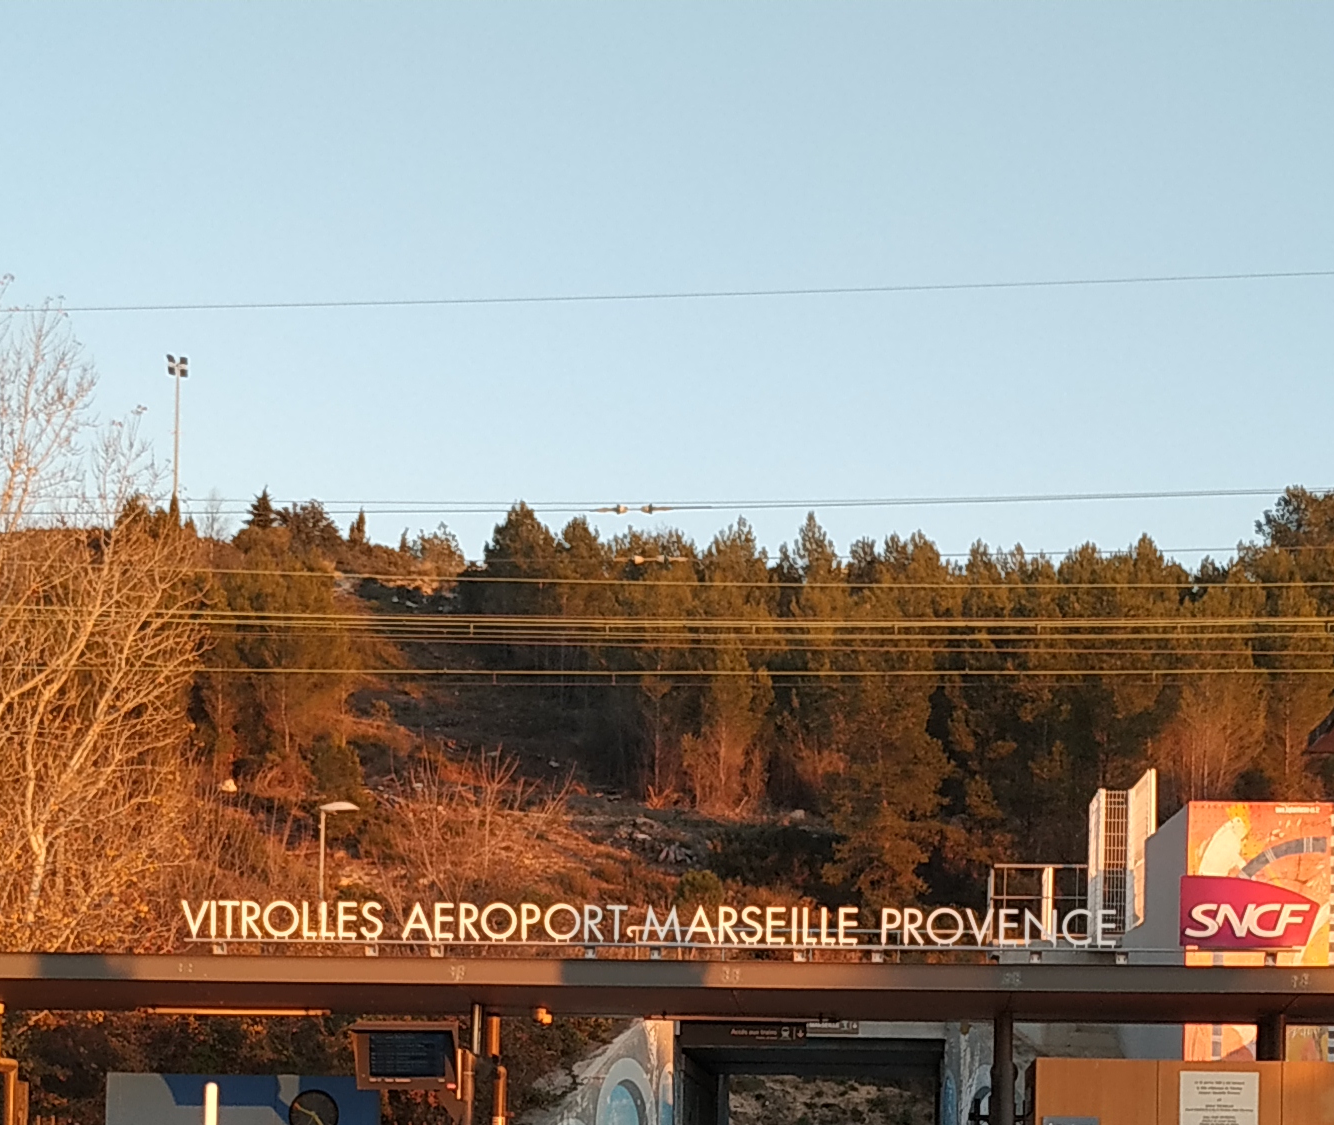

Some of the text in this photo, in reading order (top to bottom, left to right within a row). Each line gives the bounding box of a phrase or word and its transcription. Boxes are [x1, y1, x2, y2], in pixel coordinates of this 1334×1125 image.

[181, 899, 1117, 946] VITROLLES AEROPORT MARSEILLE PROVENCE
[1184, 903, 1311, 938] SNCF
